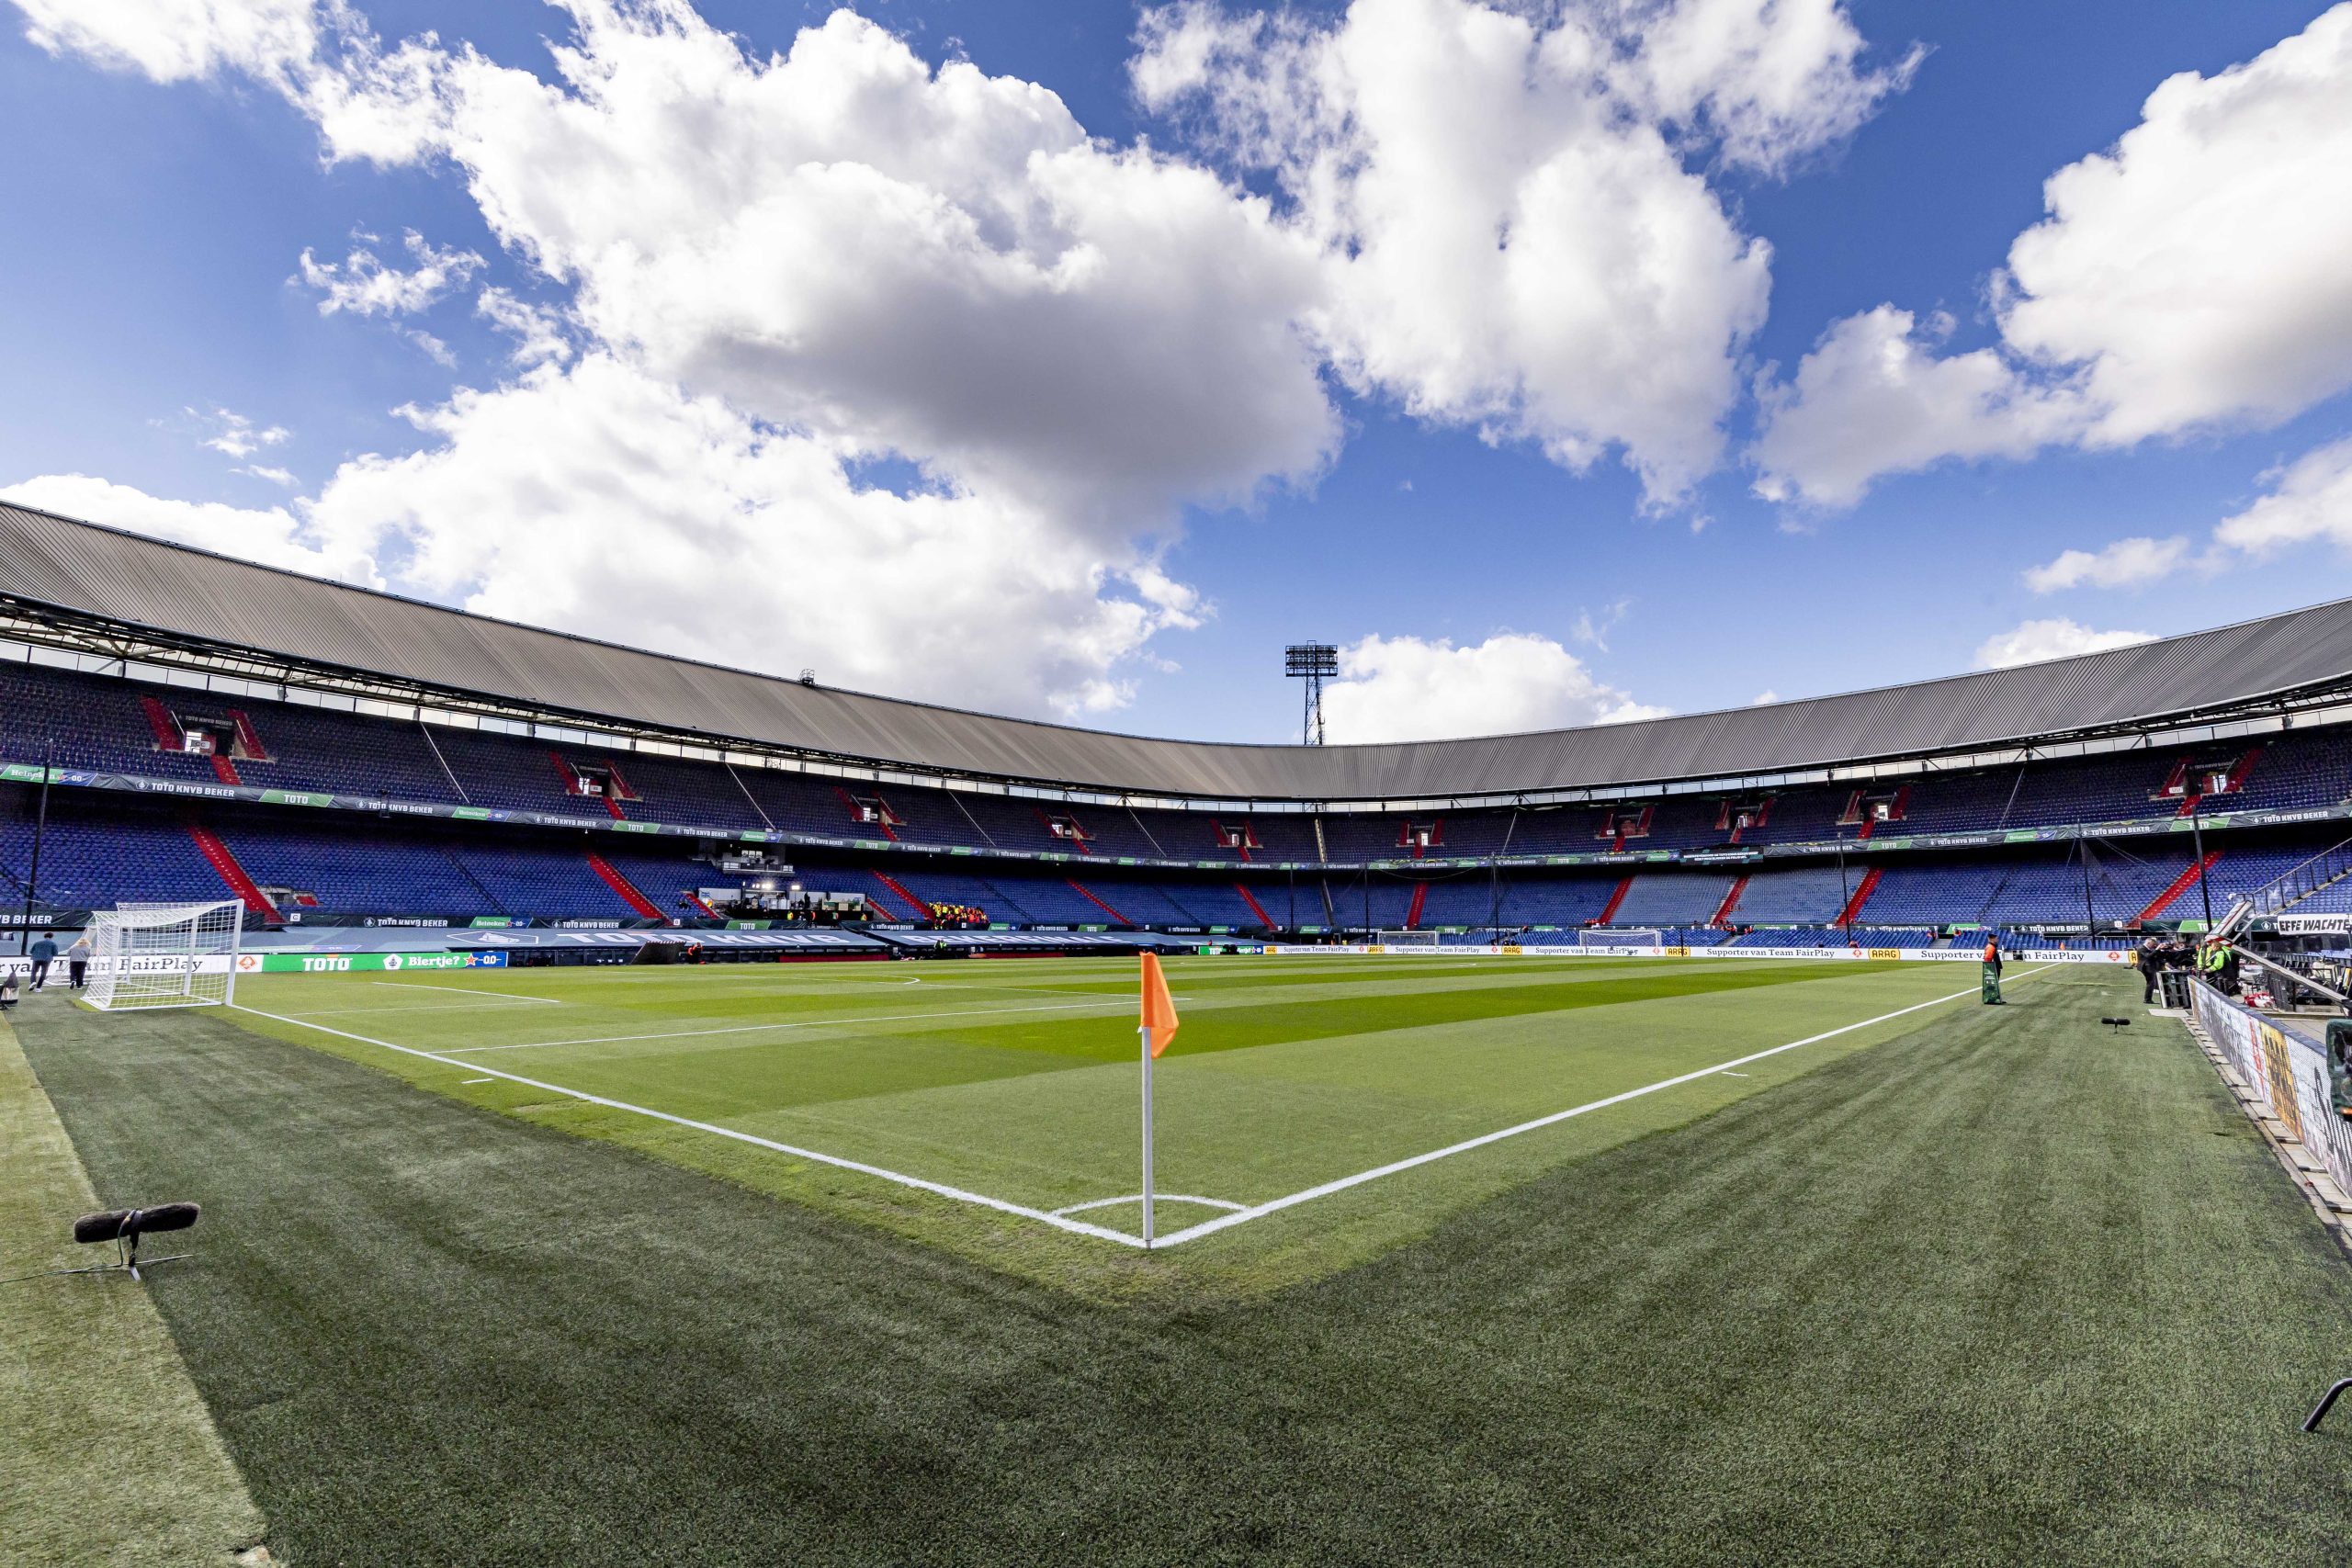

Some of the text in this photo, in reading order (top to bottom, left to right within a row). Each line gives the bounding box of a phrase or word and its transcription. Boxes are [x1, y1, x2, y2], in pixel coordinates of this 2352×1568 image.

[11, 769, 55, 781] Heinekn
[152, 782, 235, 797] TOTO KNVB BEKER
[284, 794, 309, 805] TOTO
[368, 801, 434, 815] TOTO KNVB BEKER
[544, 816, 596, 828] TOTO KNVB BEKER
[2263, 810, 2329, 823] TOTO KNVB BEKER
[628, 823, 644, 832] TOTO
[2091, 828, 2108, 836] TOTO
[2128, 826, 2150, 834] BEKER
[562, 919, 579, 928] TOTO
[740, 922, 755, 931] TOTO
[2278, 919, 2301, 931] EFFE
[1454, 946, 1480, 954] FairPlay
[1707, 948, 1749, 957] Supporter
[1796, 949, 1835, 958] FairPlay
[408, 956, 460, 967] Biertje?
[1921, 951, 1973, 960] Supporter
[2035, 952, 2085, 962] FairPlay
[302, 957, 353, 971] TOTO
